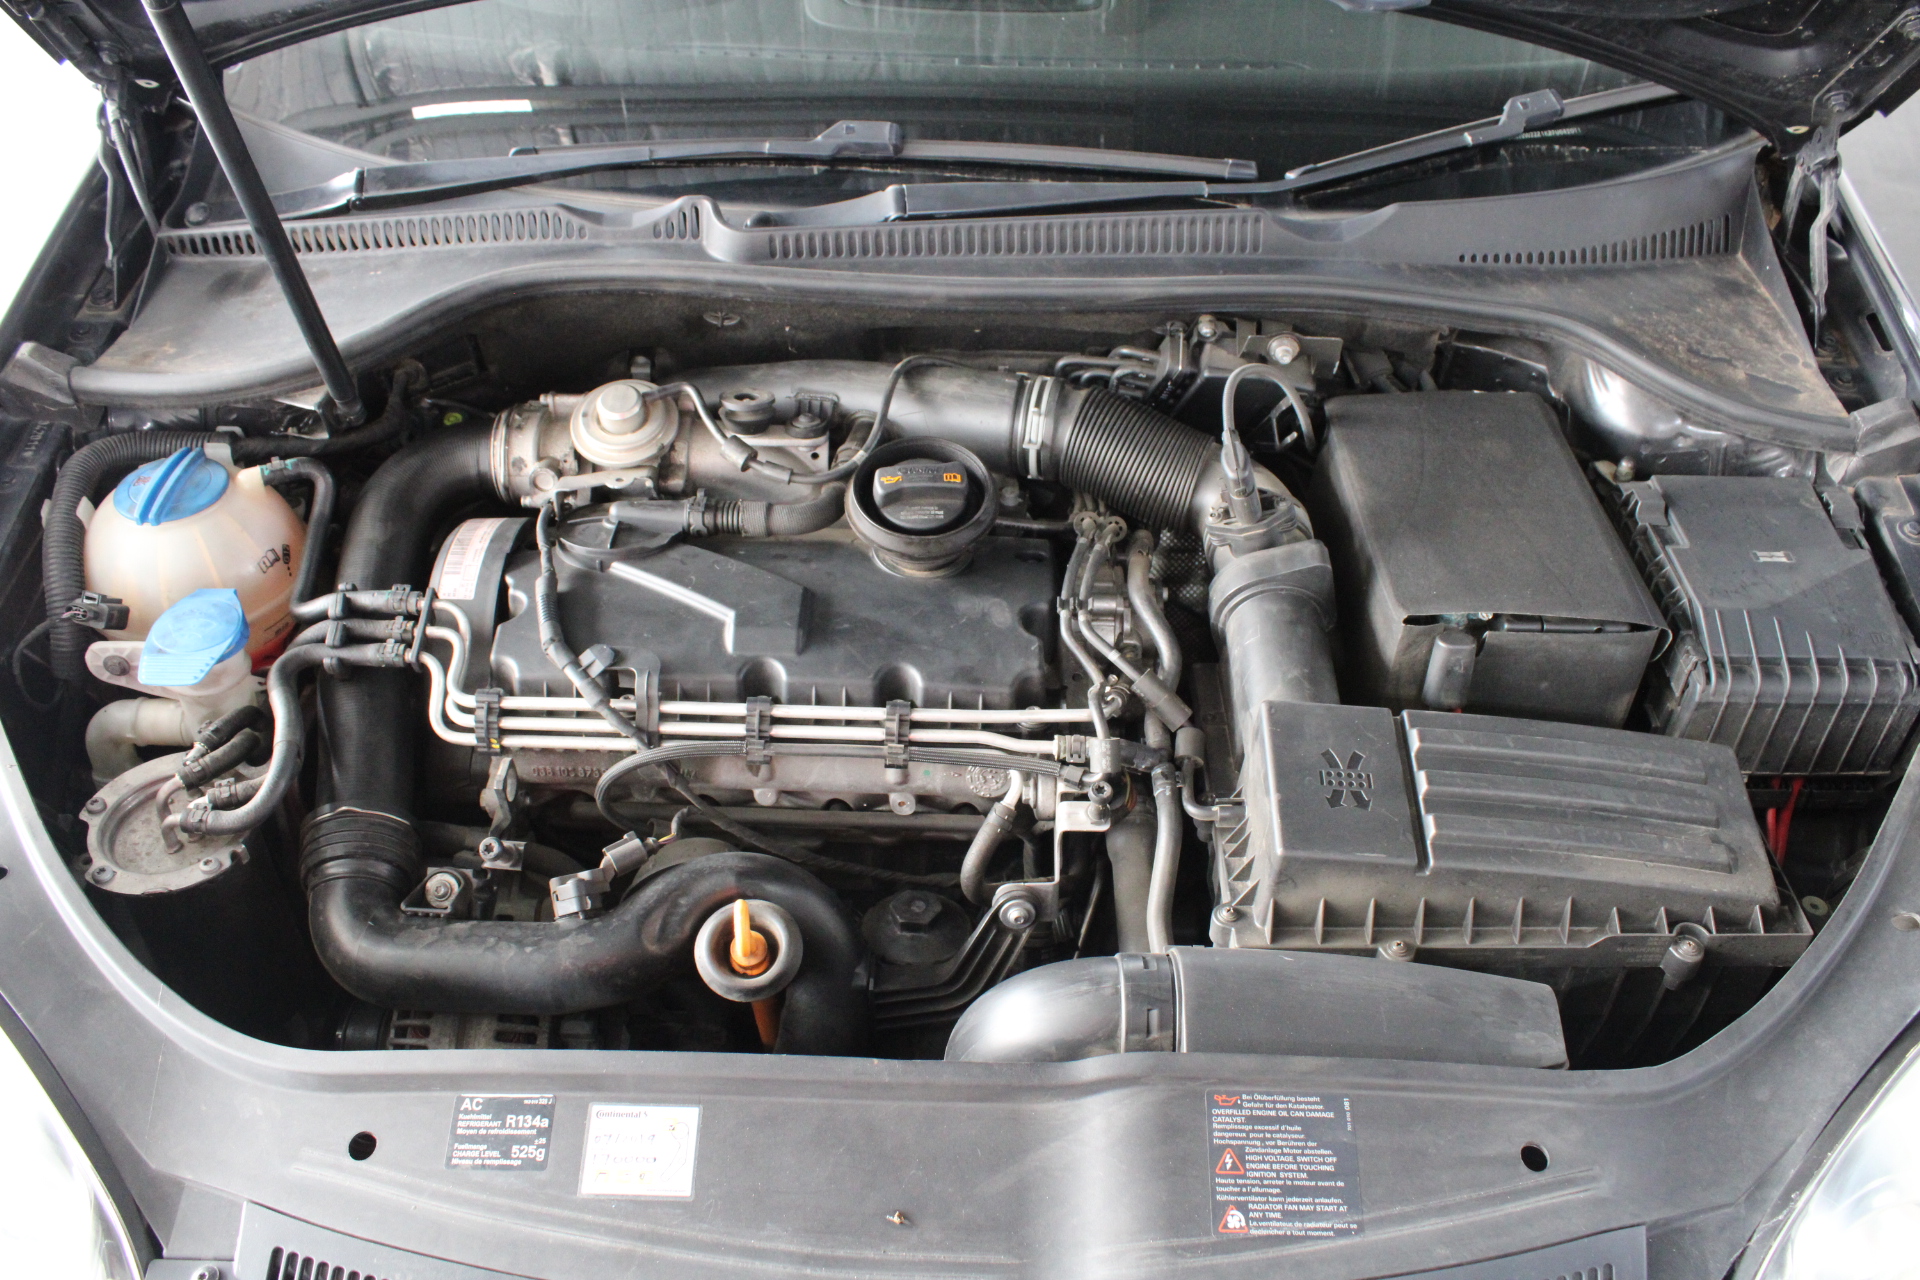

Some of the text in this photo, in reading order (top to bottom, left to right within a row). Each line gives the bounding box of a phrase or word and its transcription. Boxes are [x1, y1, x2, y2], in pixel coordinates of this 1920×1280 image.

[1253, 1093, 1296, 1102] Ölüberfüllung
[460, 1098, 483, 1111] AC
[1288, 1103, 1325, 1111] Katalysator.
[596, 1110, 642, 1119] Continental
[1211, 1108, 1251, 1116] OVERFILLED
[505, 1114, 549, 1128] R134a
[1212, 1123, 1253, 1131] Remplissage
[456, 1128, 477, 1136] Moyen
[1272, 1132, 1306, 1140] catalyseur.
[1213, 1138, 1261, 1146] Hochspannung
[452, 1145, 546, 1161] CHARGE LEVEL 525g
[483, 1158, 522, 1167] remplissage
[1216, 1194, 1267, 1202] Kühlerventilator
[1285, 1196, 1313, 1204] jederzeit
[1248, 1203, 1283, 1211] RADIATOR
[1315, 1204, 1337, 1212] START
[1258, 1220, 1293, 1228] ventilateur
